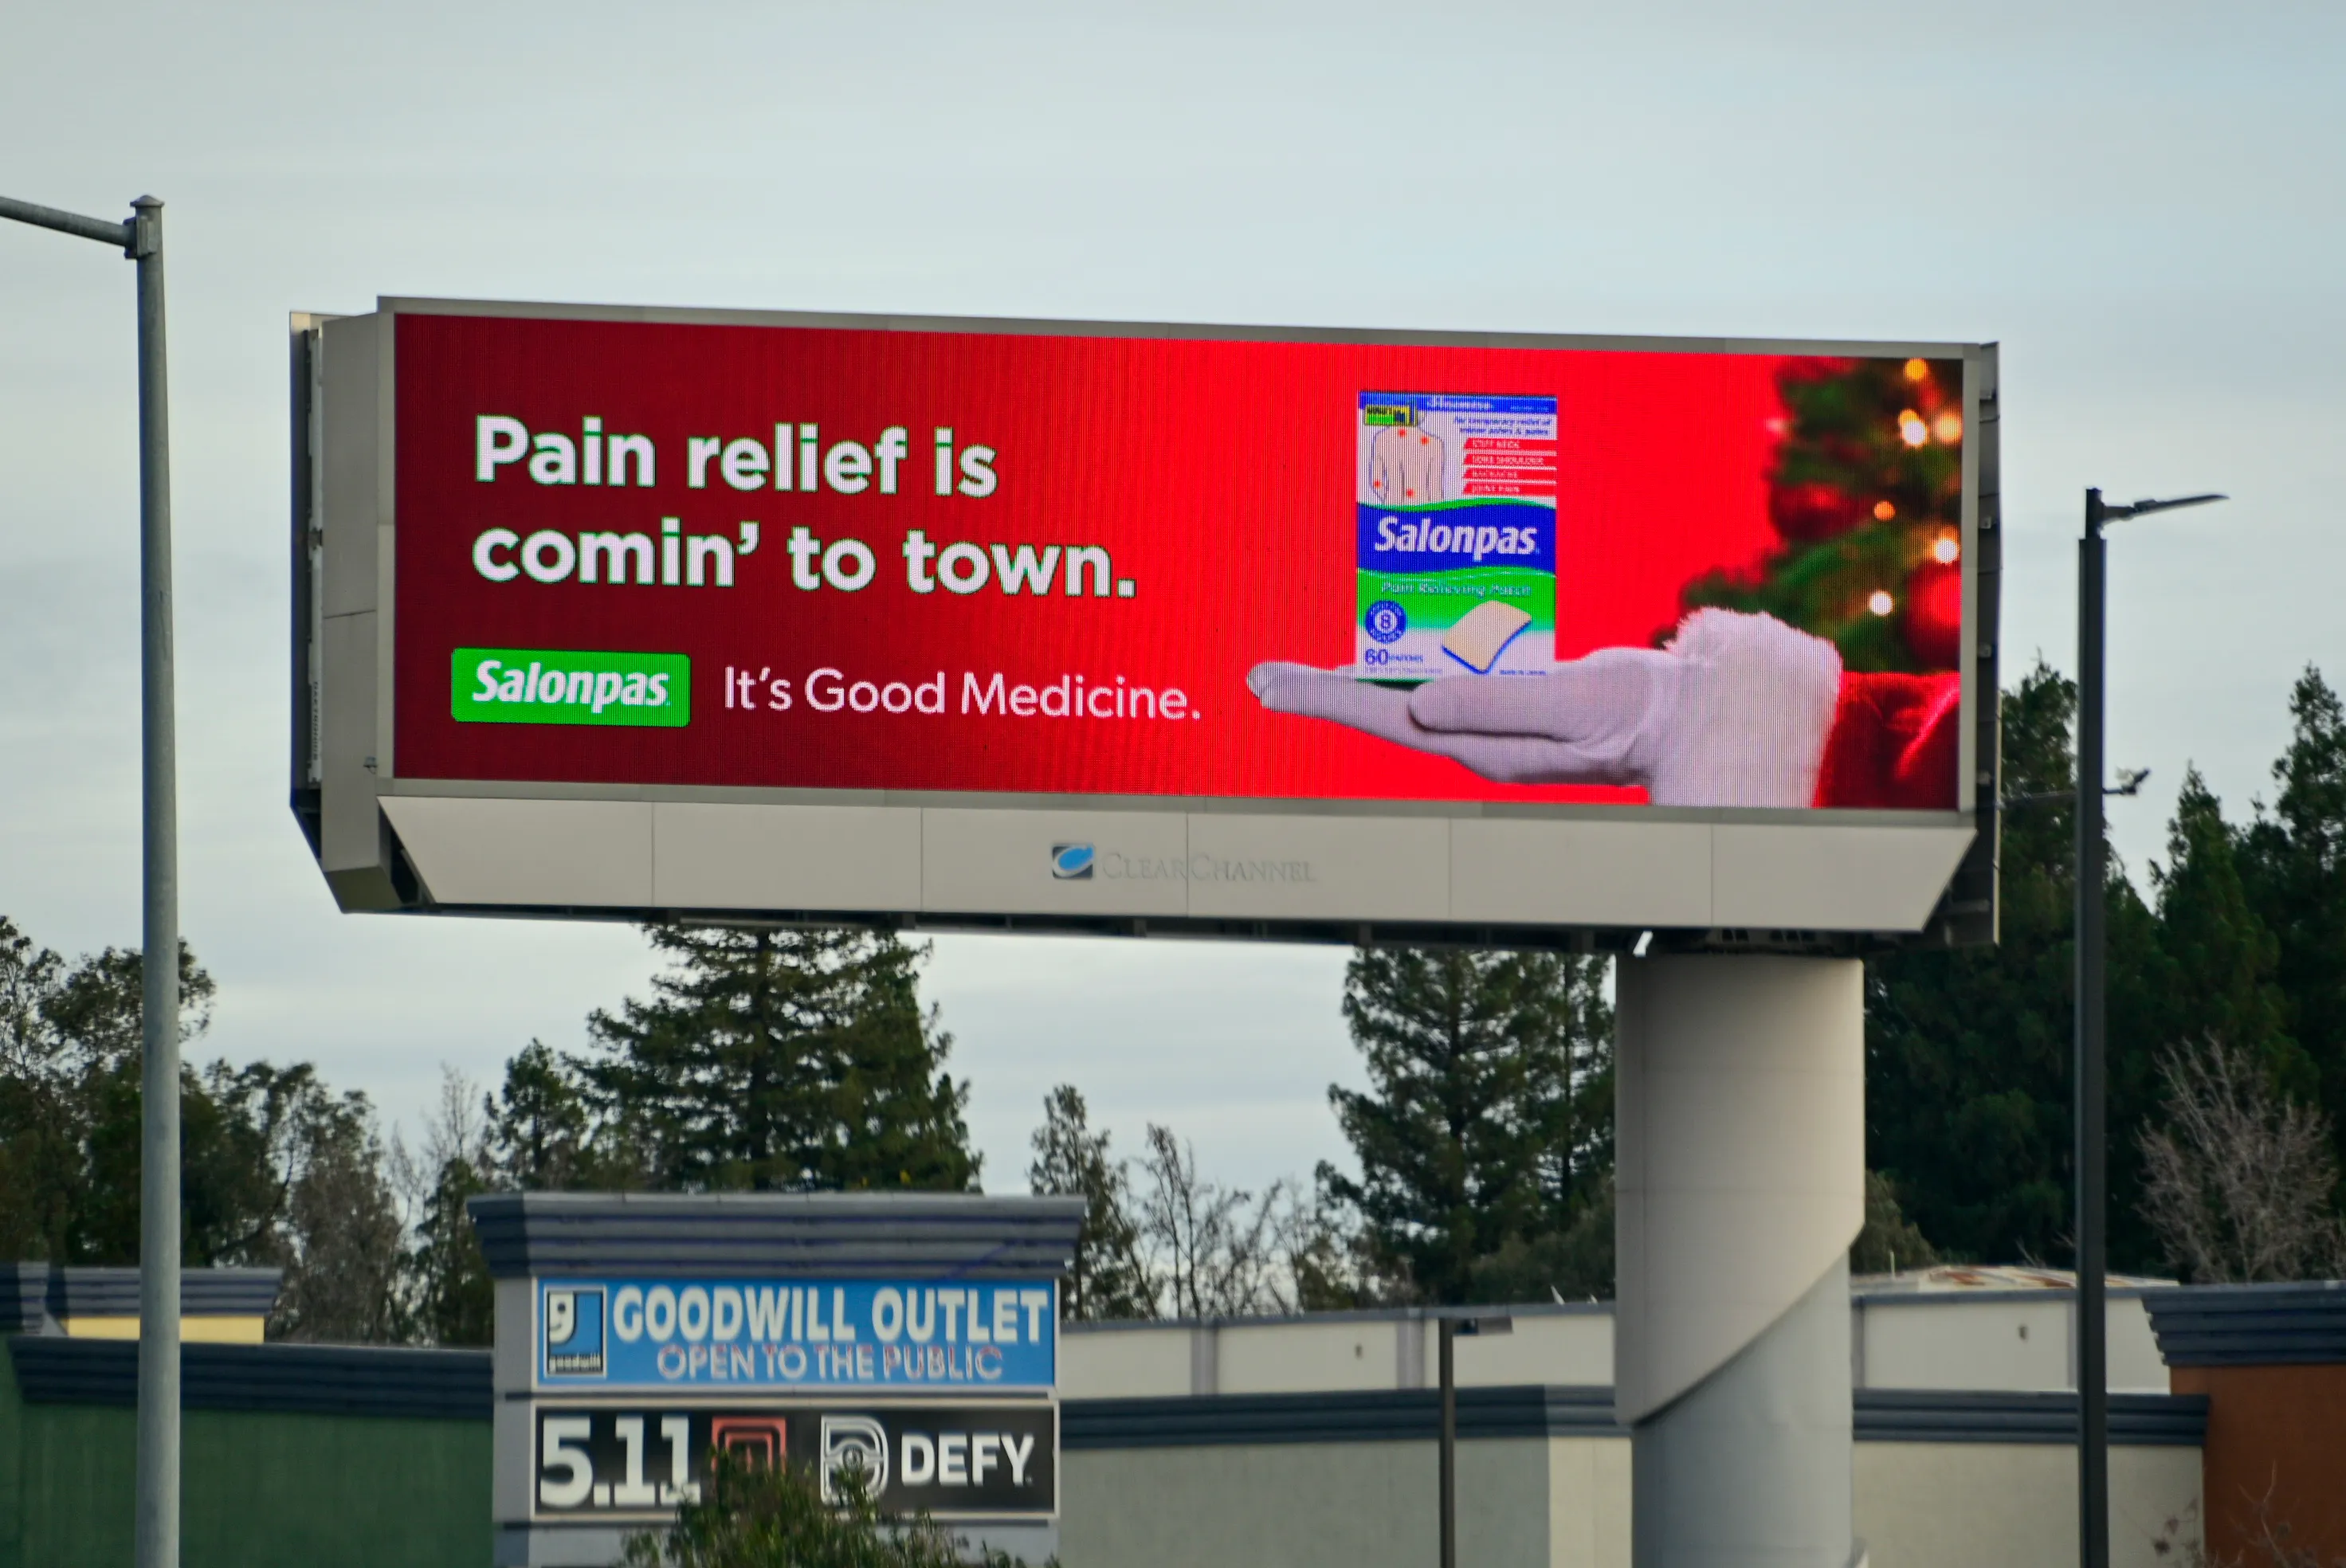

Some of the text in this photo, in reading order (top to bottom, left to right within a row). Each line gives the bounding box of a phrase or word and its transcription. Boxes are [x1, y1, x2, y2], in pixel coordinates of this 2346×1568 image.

[475, 414, 998, 499] Pain relief is
[472, 516, 1136, 598] comin’ to town.
[1375, 515, 1538, 563] Salonpas
[1364, 648, 1390, 665] 60
[472, 659, 670, 714] Salonpas
[724, 666, 1200, 720] It’s Good Medicine.
[613, 1284, 1049, 1345] GOODWILL OUTLET
[657, 1343, 1003, 1382] OPEN TO THE PUBLIC
[539, 1415, 701, 1509] 5.11
[901, 1433, 1034, 1488] DEFY
